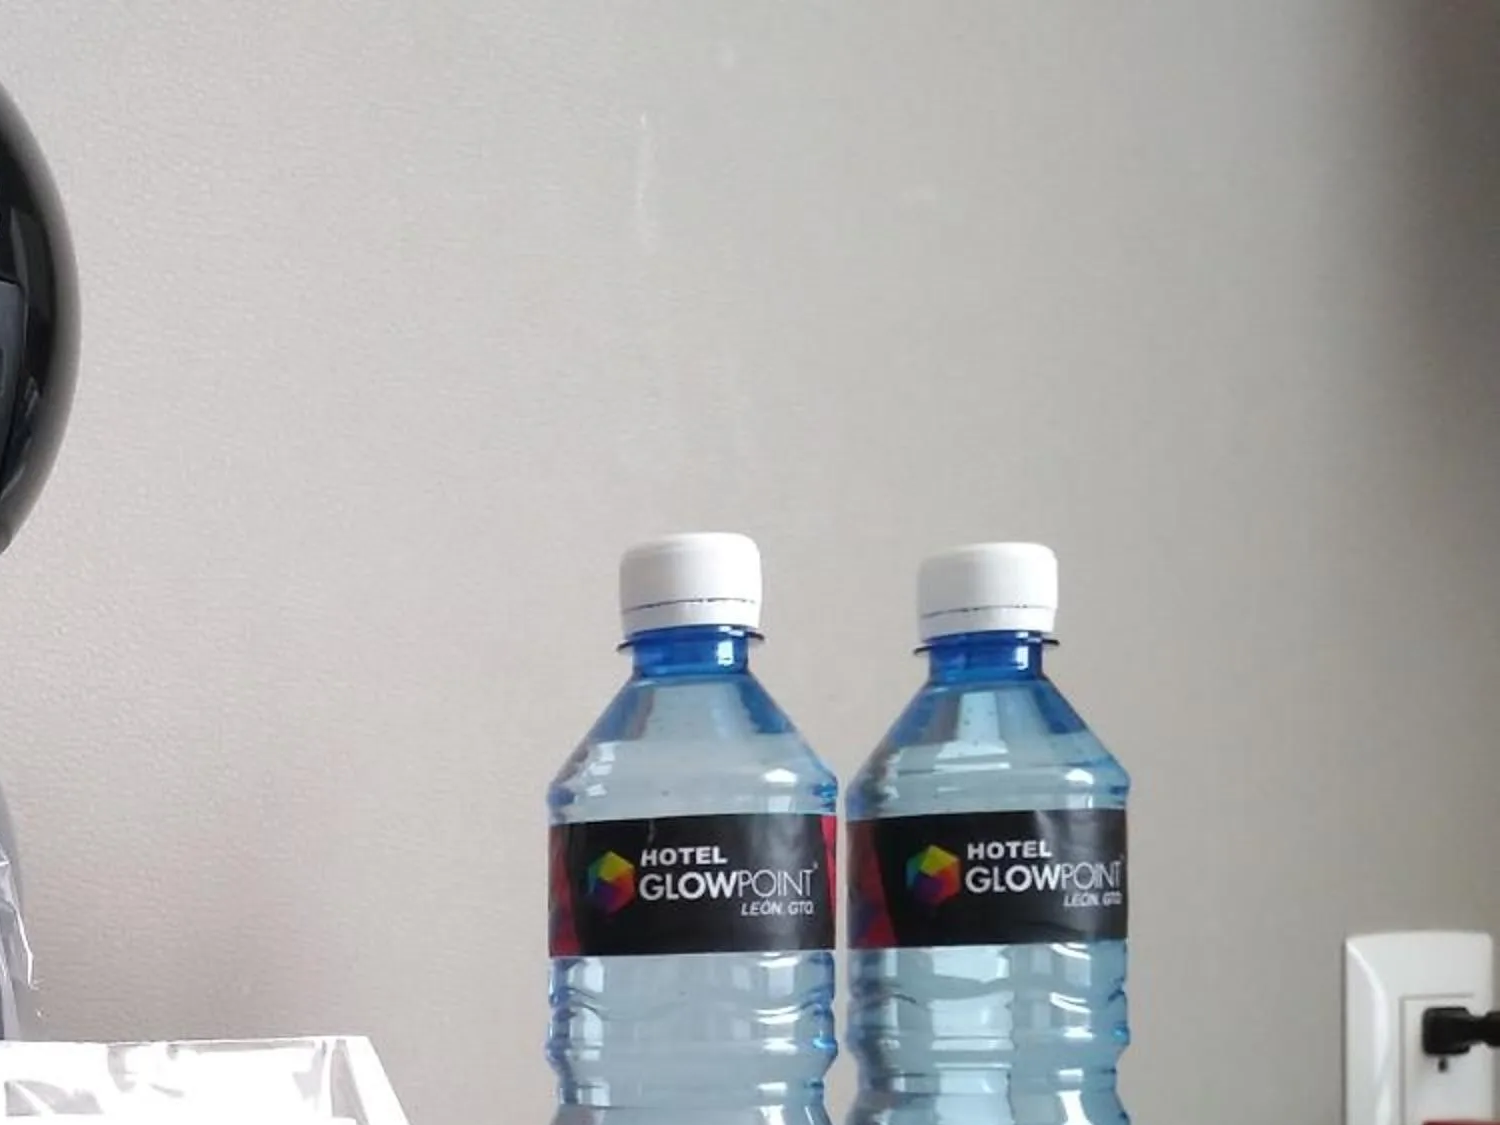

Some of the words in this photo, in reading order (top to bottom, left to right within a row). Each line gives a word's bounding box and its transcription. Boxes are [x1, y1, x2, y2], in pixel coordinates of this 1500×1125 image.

[640, 846, 728, 867] HOTEL
[967, 840, 1052, 860] HOTEL
[639, 869, 814, 900] GLOWPOINT
[965, 861, 1121, 893] GLOWPOINT
[787, 901, 814, 916] GTO
